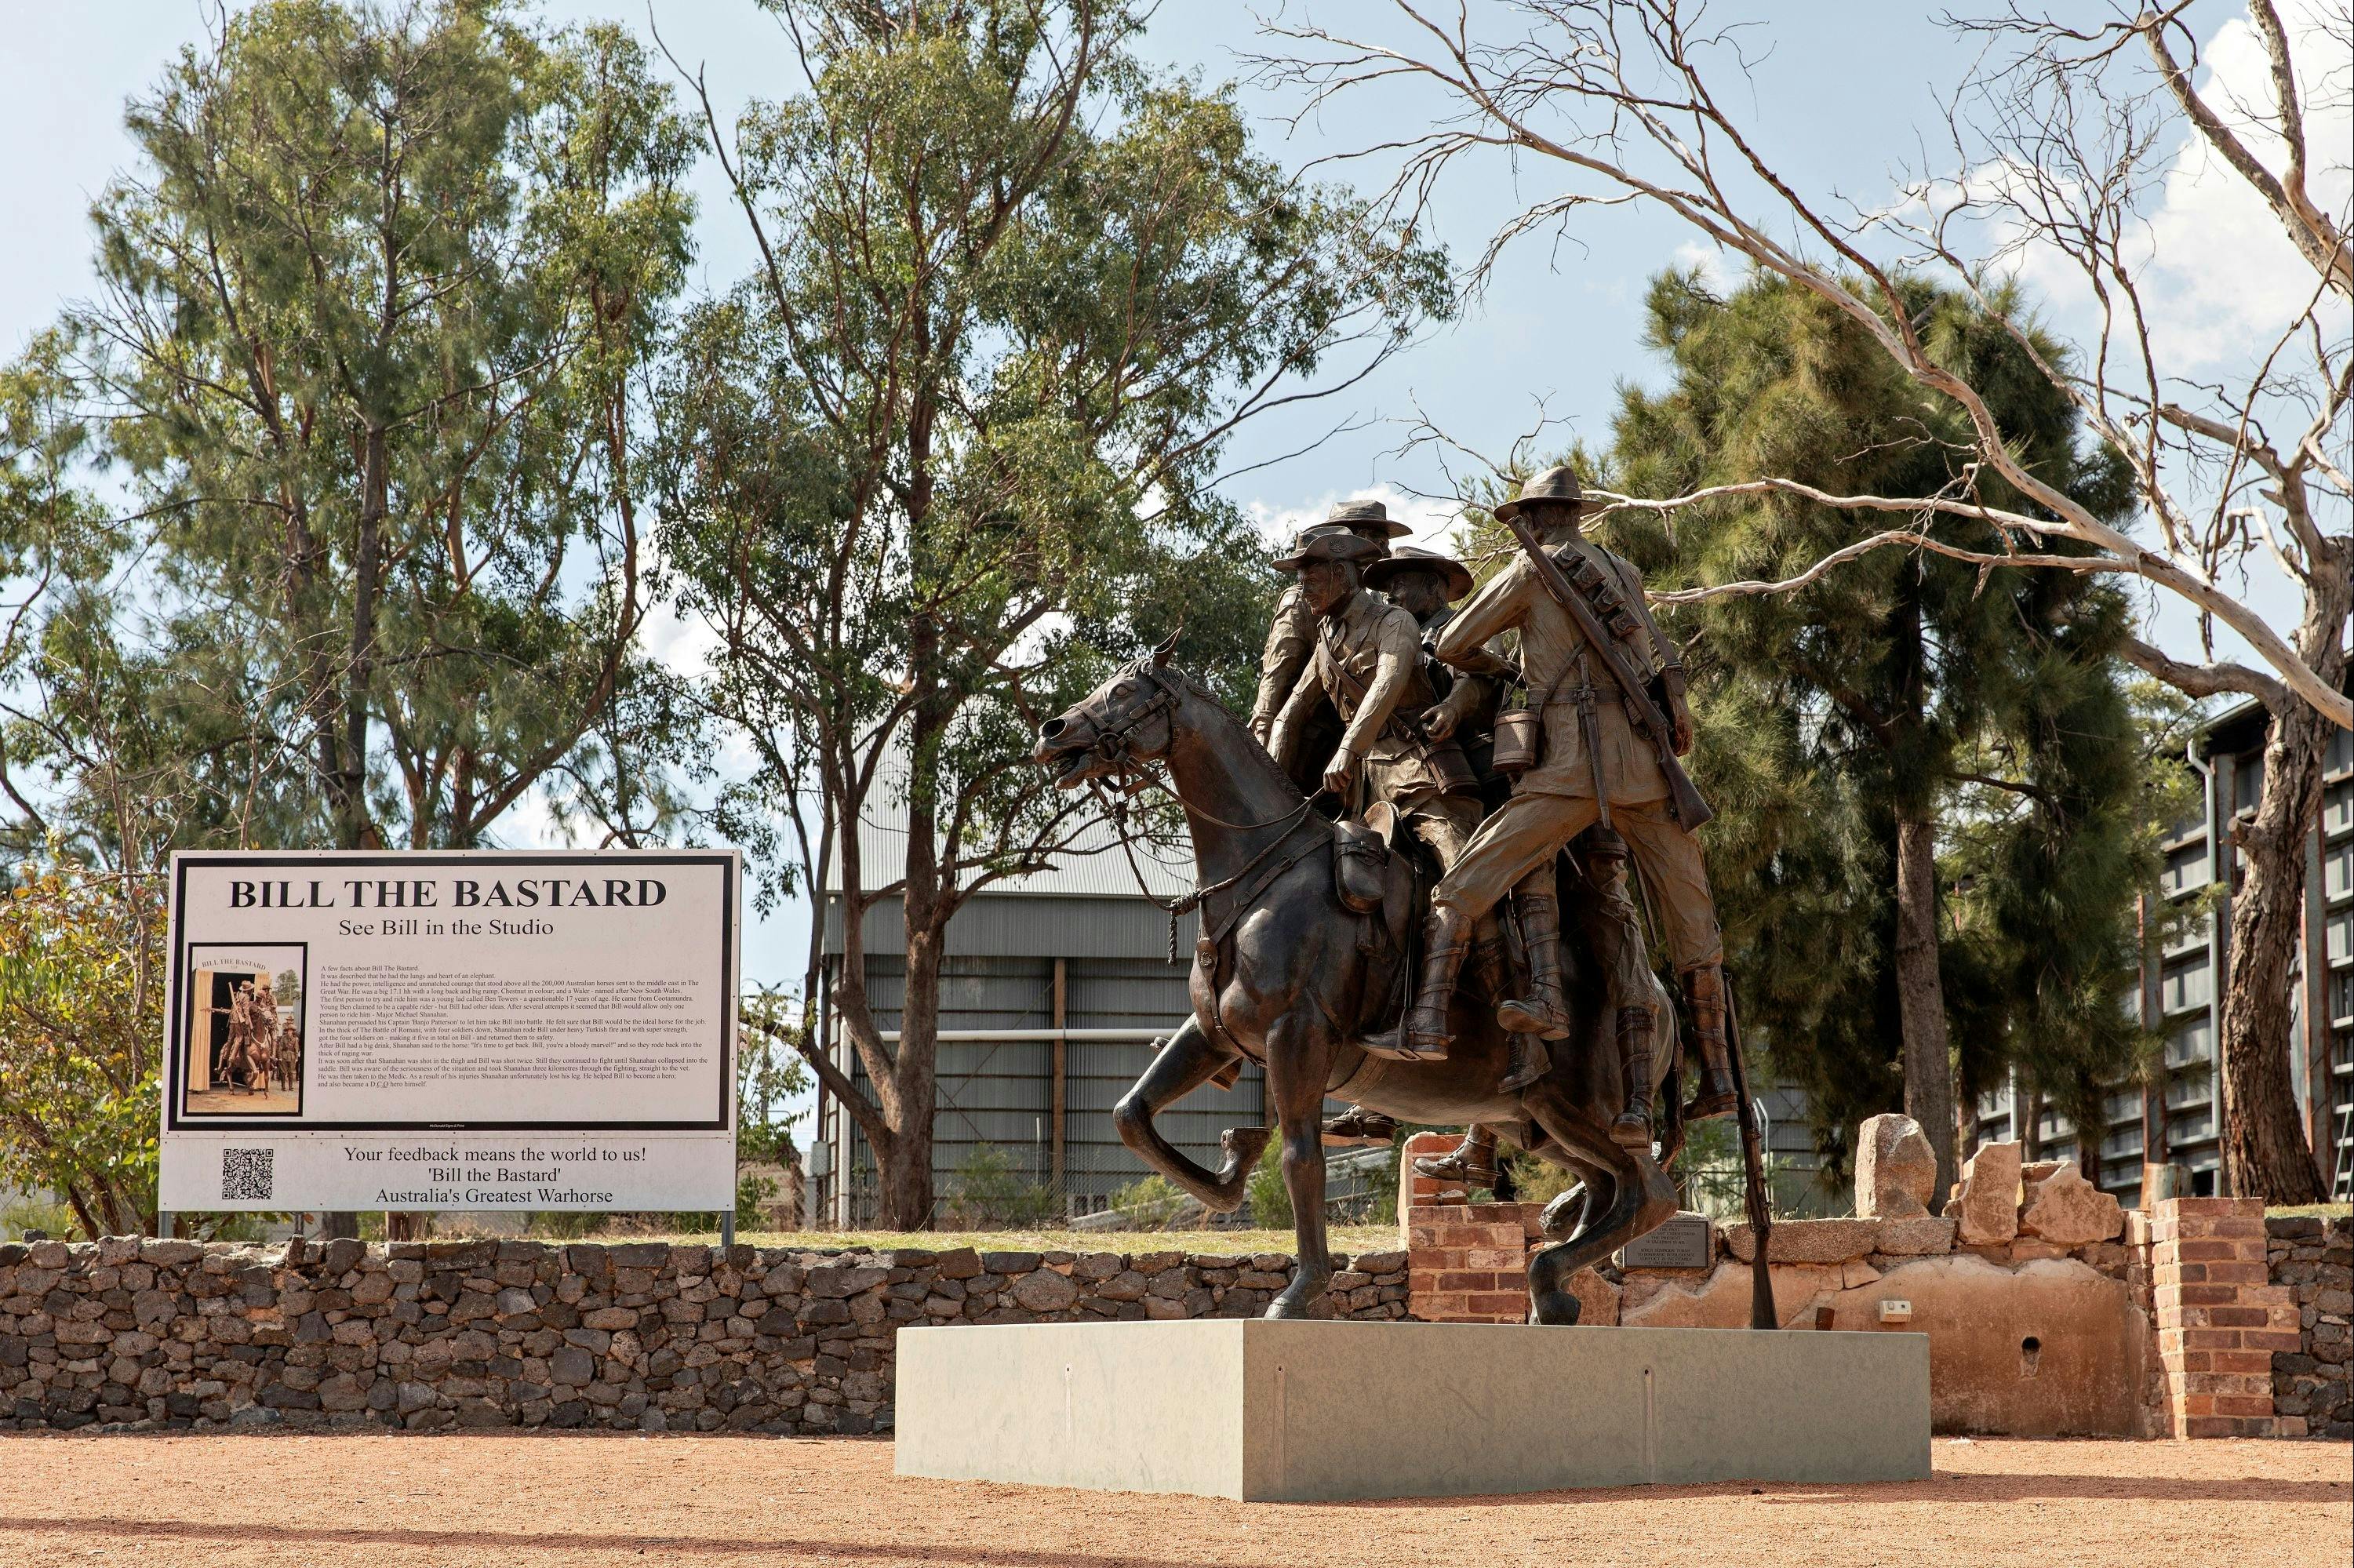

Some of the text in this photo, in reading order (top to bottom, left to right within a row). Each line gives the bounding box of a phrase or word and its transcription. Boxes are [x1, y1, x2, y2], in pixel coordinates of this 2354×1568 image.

[228, 879, 668, 908] BILL THE BASTARD
[339, 919, 554, 936] See Bill in the Studio
[202, 959, 219, 968] BILL
[235, 959, 267, 970] BASTARD
[344, 1147, 646, 1162] Your feedback means the world to us!
[428, 1167, 562, 1182] 'Bill the Bastard'
[375, 1188, 613, 1203] Australia's Greatest Warhorse
